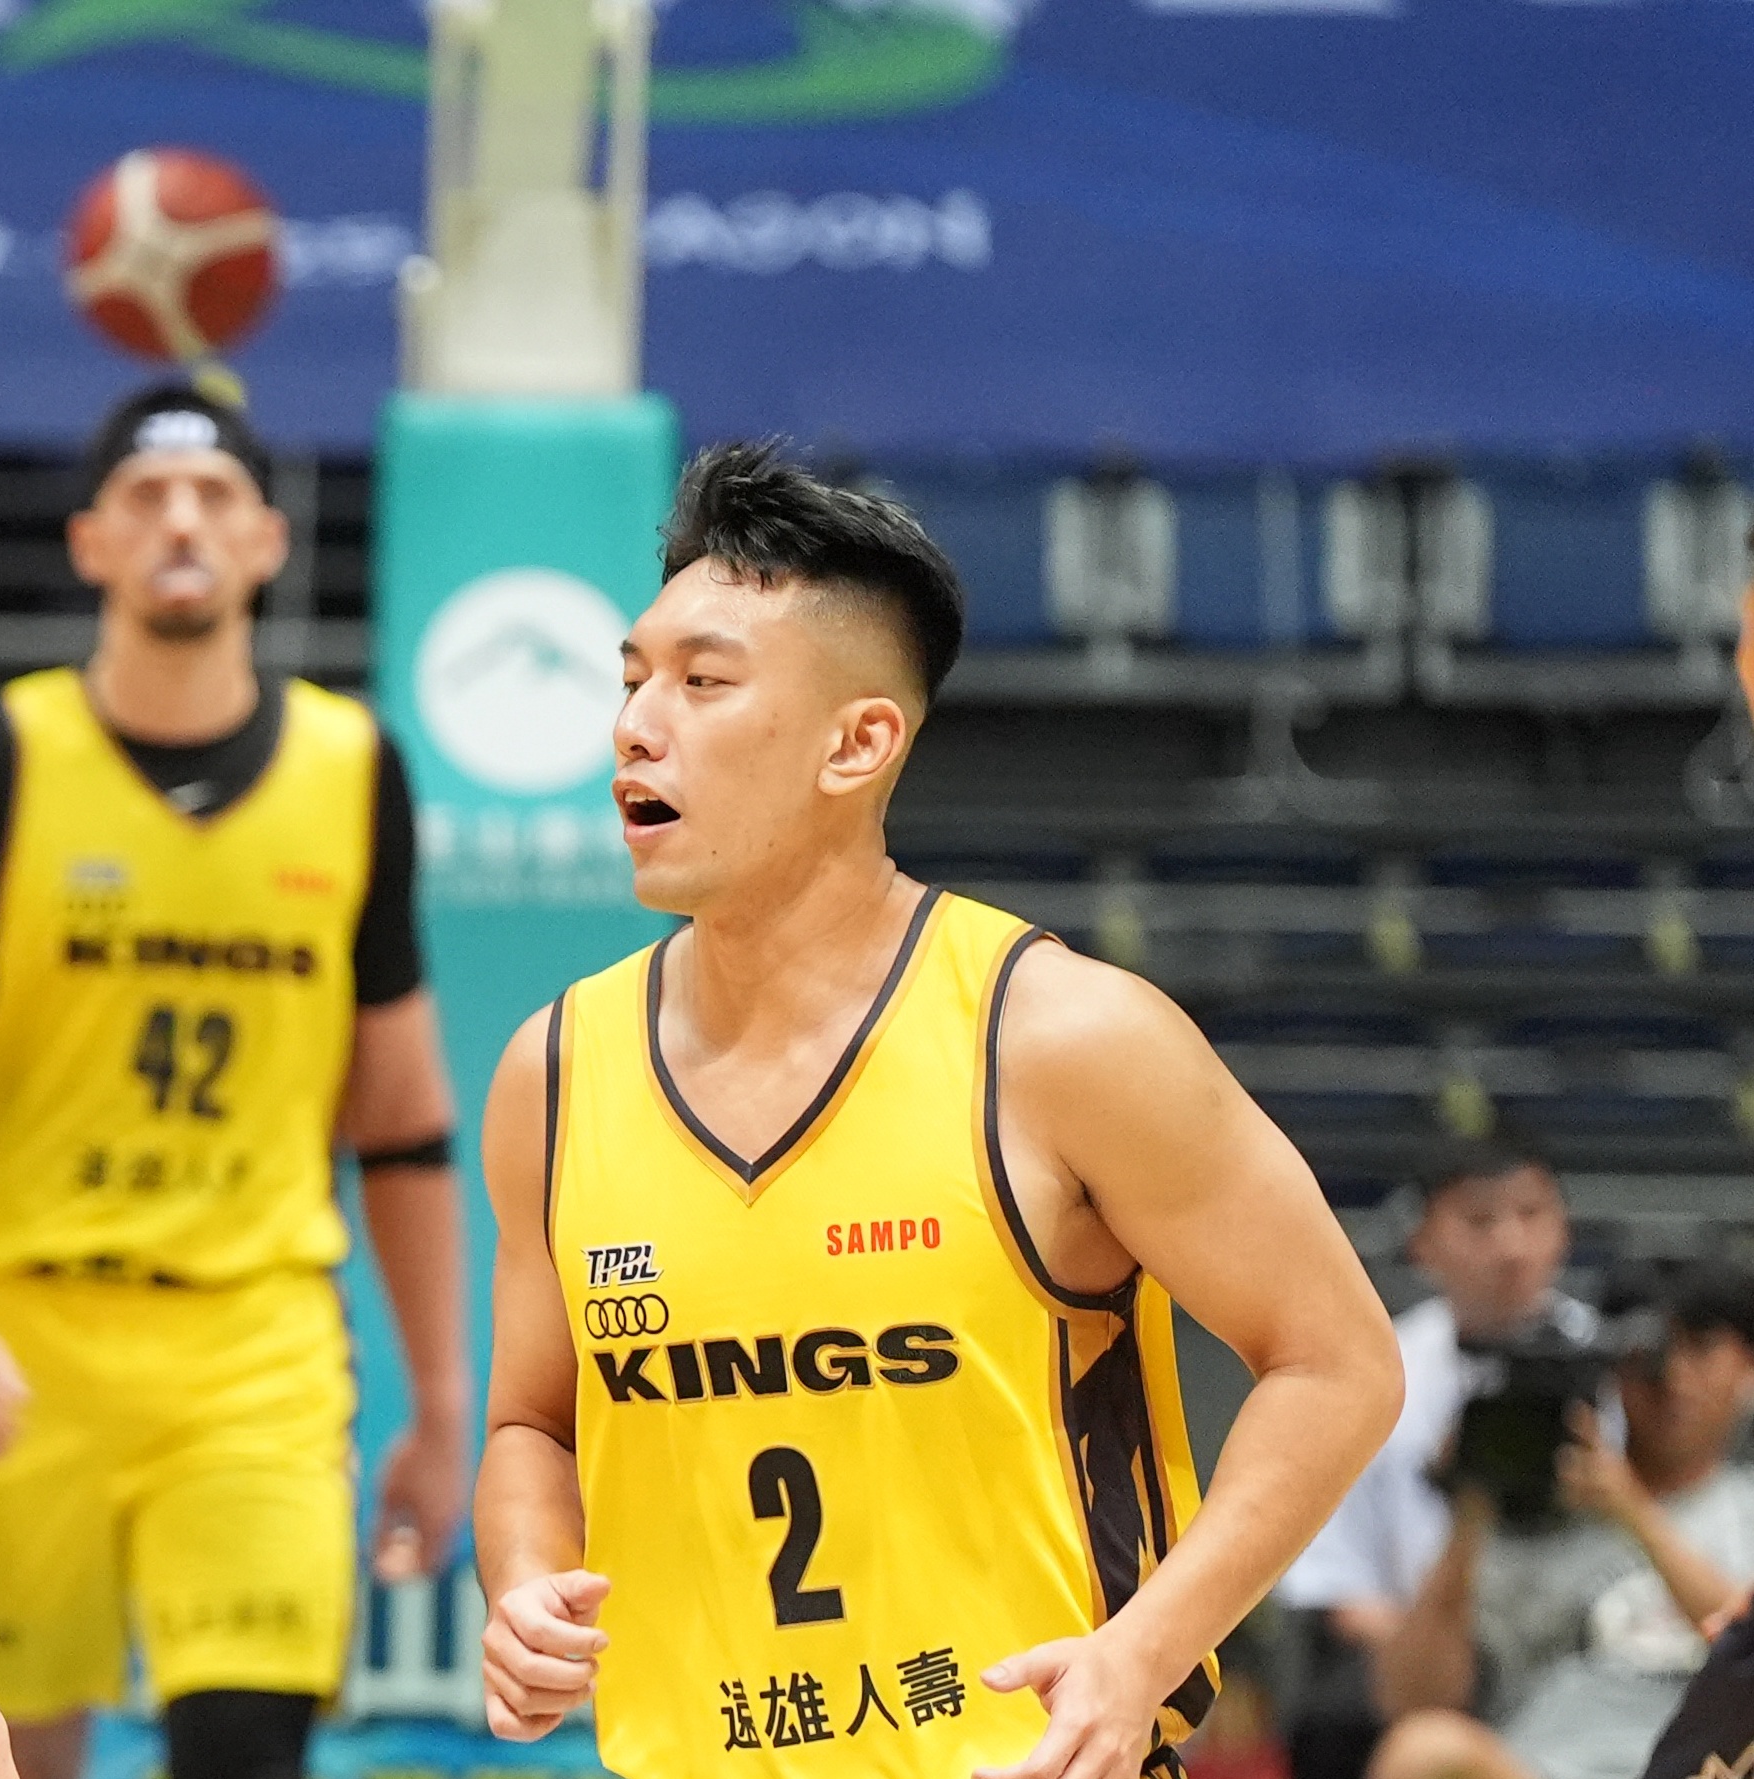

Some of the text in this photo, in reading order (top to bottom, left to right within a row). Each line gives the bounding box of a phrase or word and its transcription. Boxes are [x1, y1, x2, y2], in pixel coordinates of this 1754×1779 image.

[134, 1005, 234, 1122] 42
[581, 1243, 664, 1289] TPBL
[826, 1217, 942, 1257] SAMPO
[591, 1322, 961, 1405] KINGS
[747, 1445, 848, 1631] 2
[719, 1647, 967, 1753] 遠雄人壽
